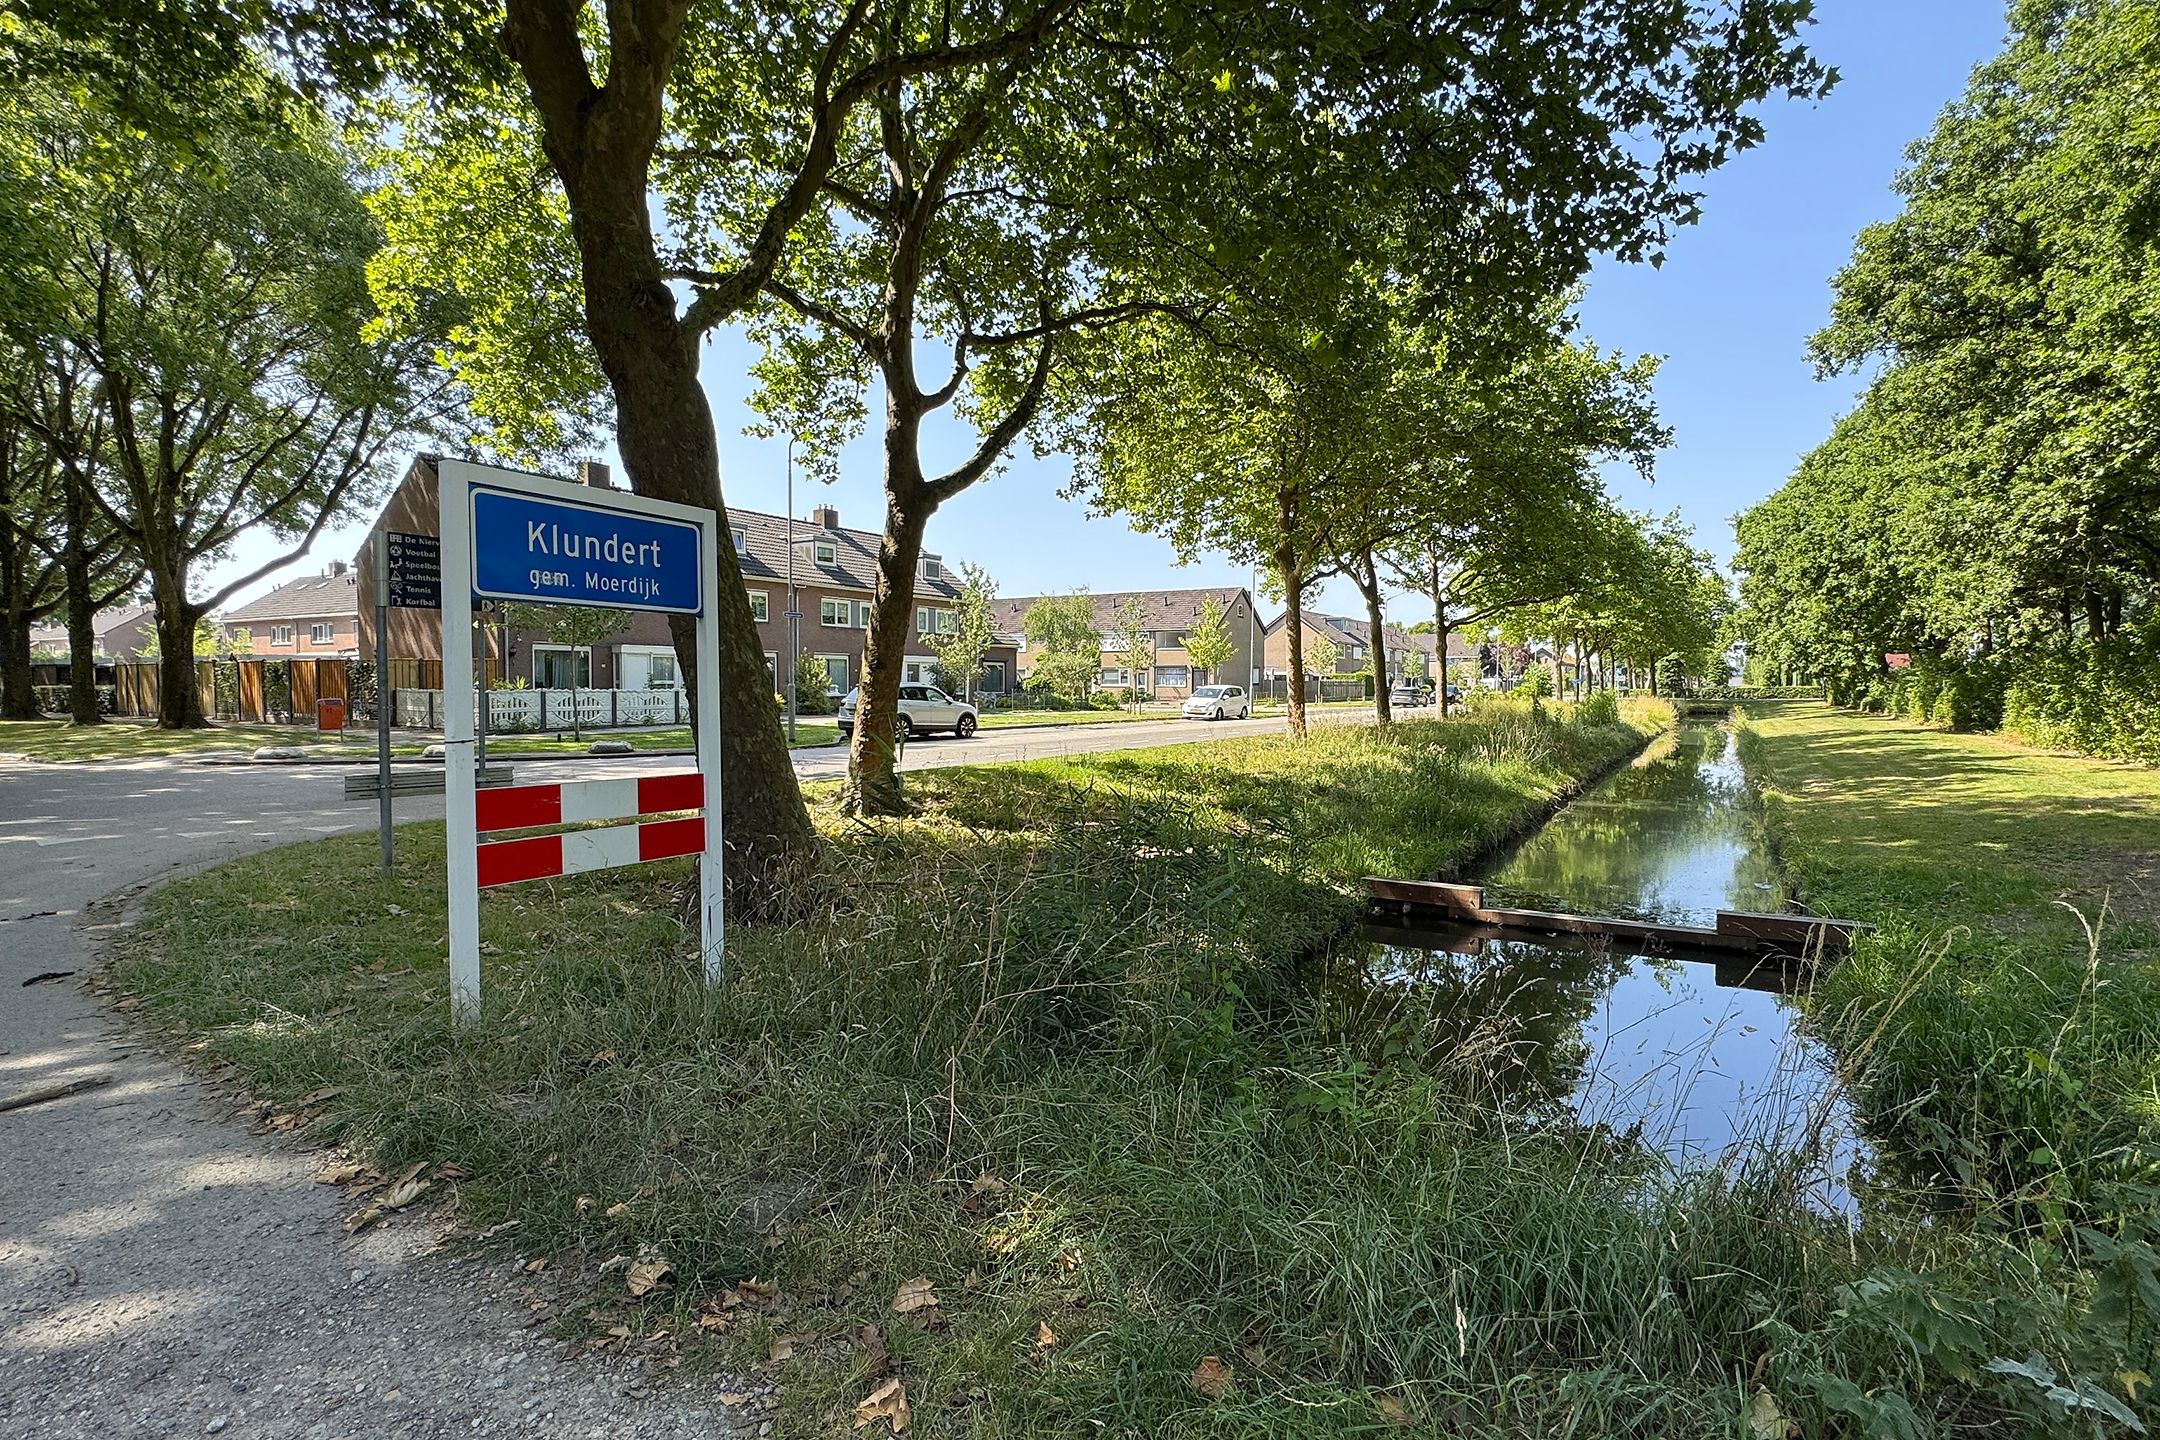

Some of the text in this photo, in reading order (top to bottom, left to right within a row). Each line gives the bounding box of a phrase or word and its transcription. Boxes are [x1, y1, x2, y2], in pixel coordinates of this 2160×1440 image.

[405, 536, 416, 544] De
[528, 520, 661, 568] Klundert
[405, 548, 436, 558] Voetbal
[529, 569, 660, 600] gem. Moerdijk
[406, 586, 431, 594] Tennis
[406, 598, 435, 606] Korfbal
